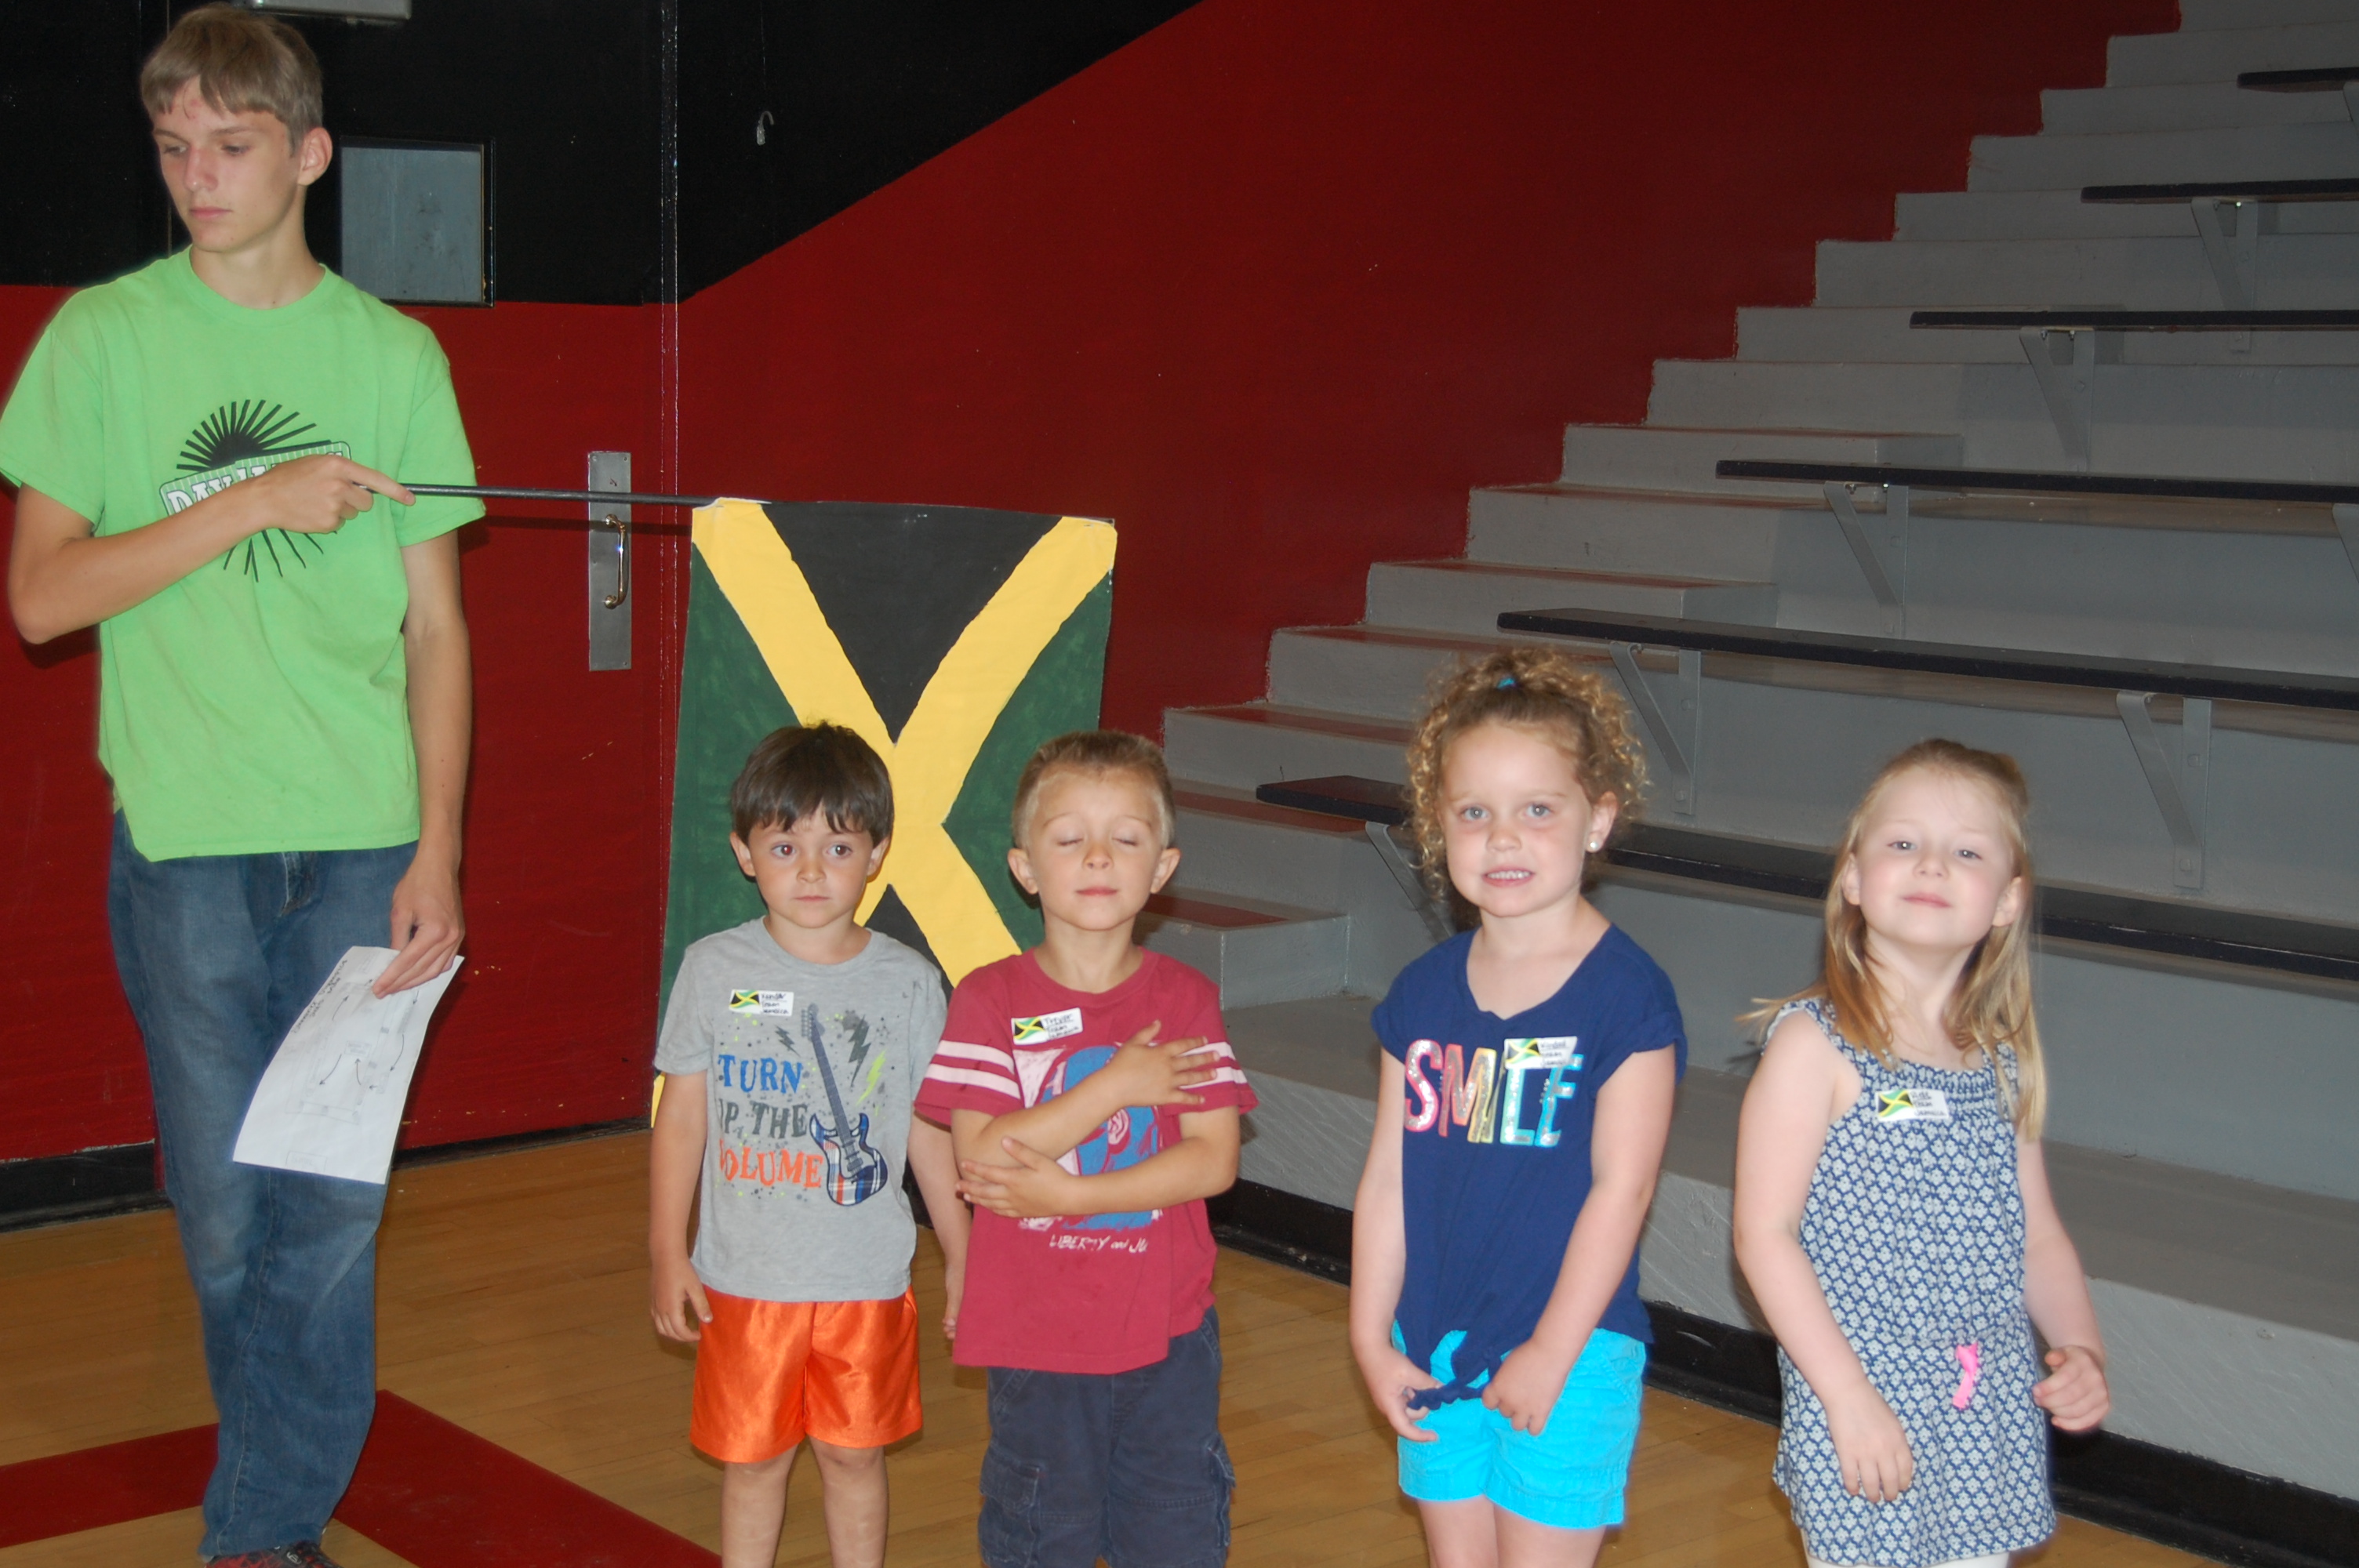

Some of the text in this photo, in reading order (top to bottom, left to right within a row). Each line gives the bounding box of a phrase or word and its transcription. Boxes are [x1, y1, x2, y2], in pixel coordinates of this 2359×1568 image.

[718, 1054, 803, 1094] TURN
[718, 1098, 809, 1138] P THE
